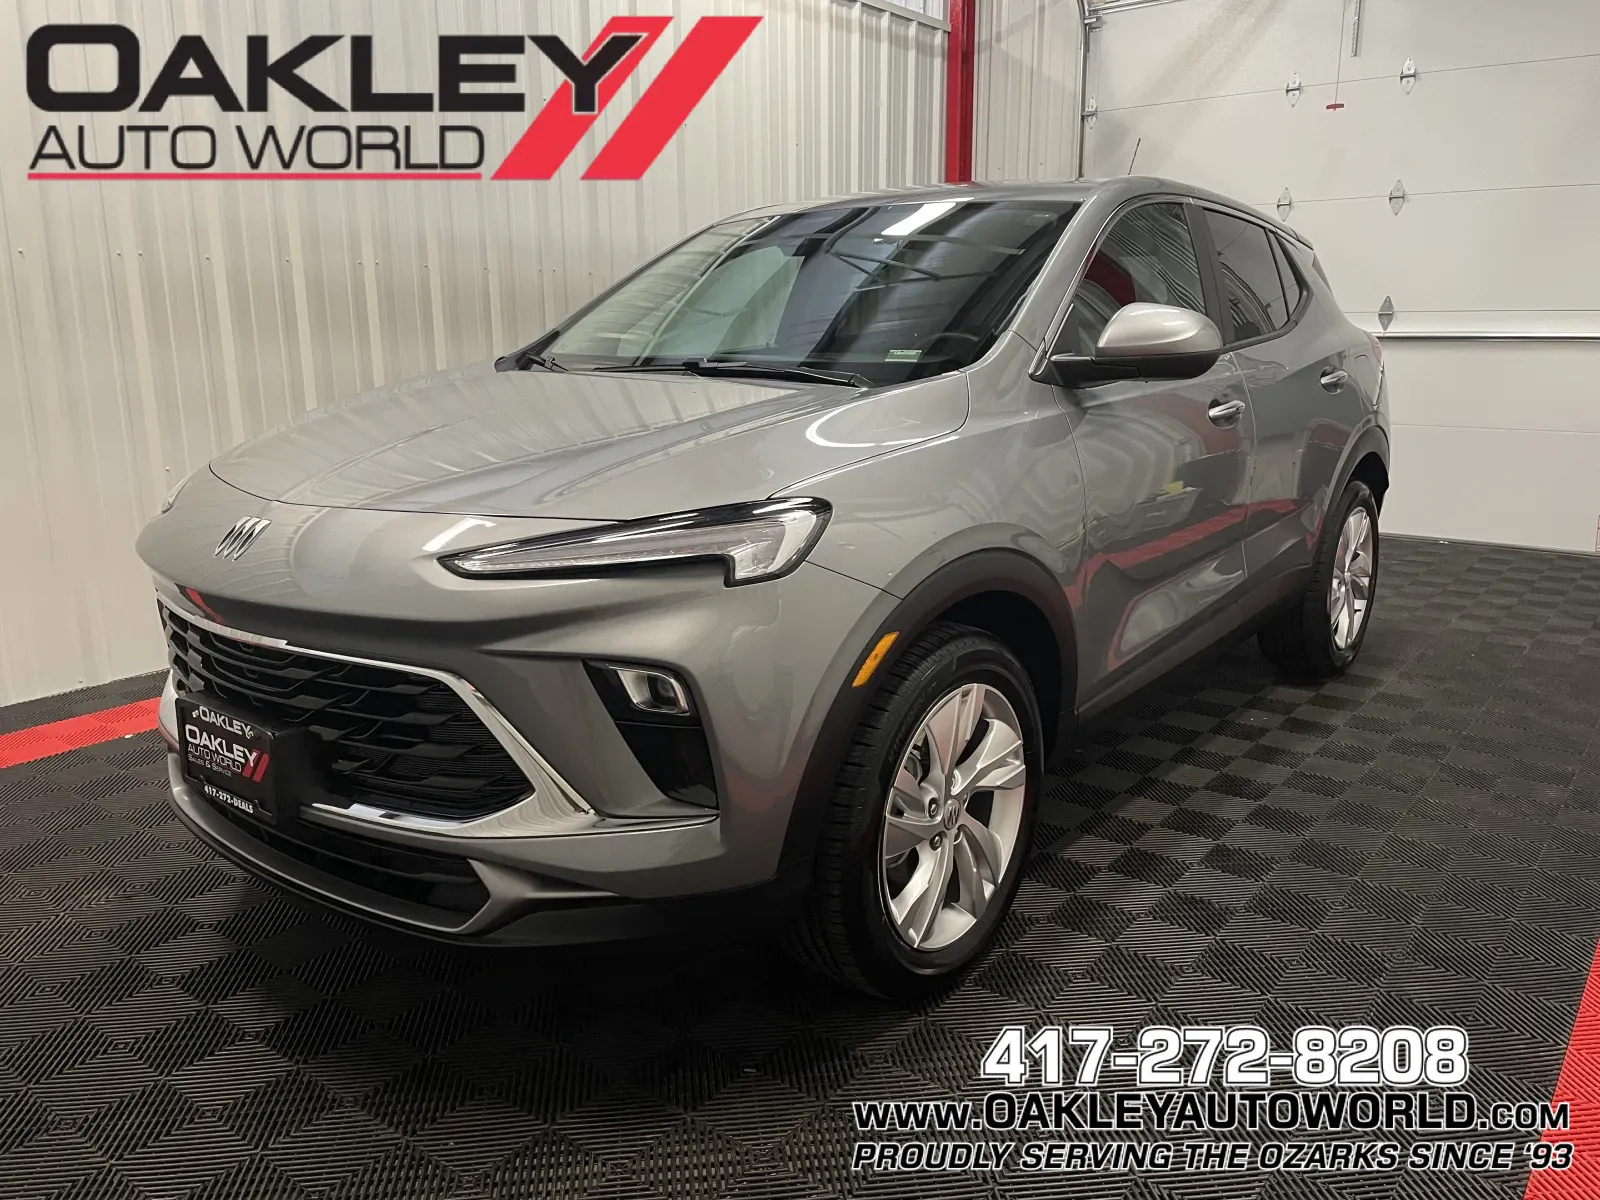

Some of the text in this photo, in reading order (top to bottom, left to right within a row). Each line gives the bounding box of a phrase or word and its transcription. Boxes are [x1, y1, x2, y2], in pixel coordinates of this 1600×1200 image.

[200, 706, 251, 736] OAKLEY
[185, 724, 257, 767] OAKLEY
[188, 744, 241, 772] AUTO WORLD
[205, 760, 211, 768] &
[204, 785, 254, 813] 417-272-DEALS
